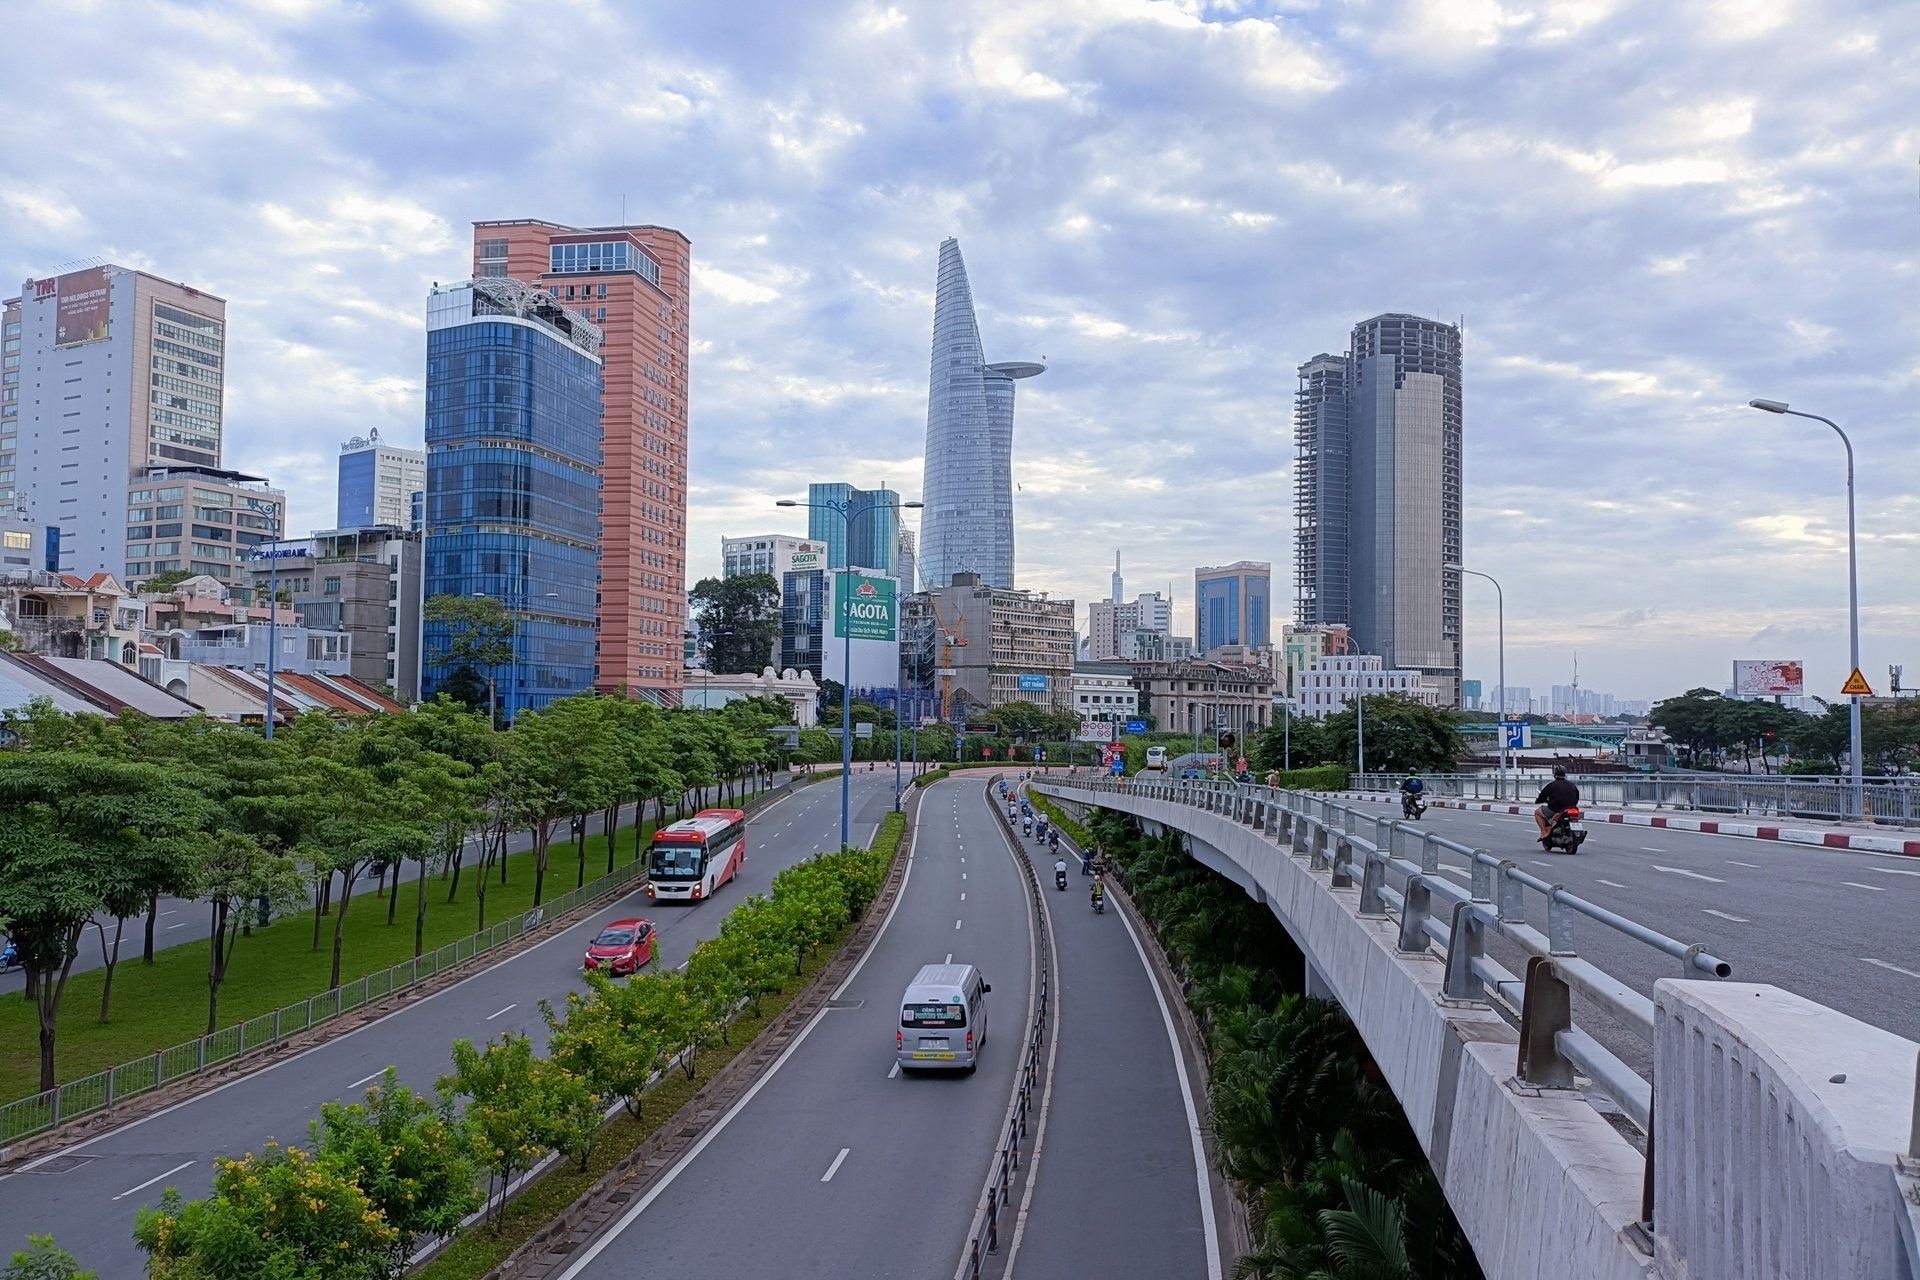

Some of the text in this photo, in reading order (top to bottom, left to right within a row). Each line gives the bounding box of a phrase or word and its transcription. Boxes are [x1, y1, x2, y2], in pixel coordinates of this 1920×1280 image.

[34, 278, 56, 296] TNR
[89, 288, 107, 297] VIETNAM
[791, 553, 817, 563] SAGOTA
[843, 601, 889, 621] SAGOTA
